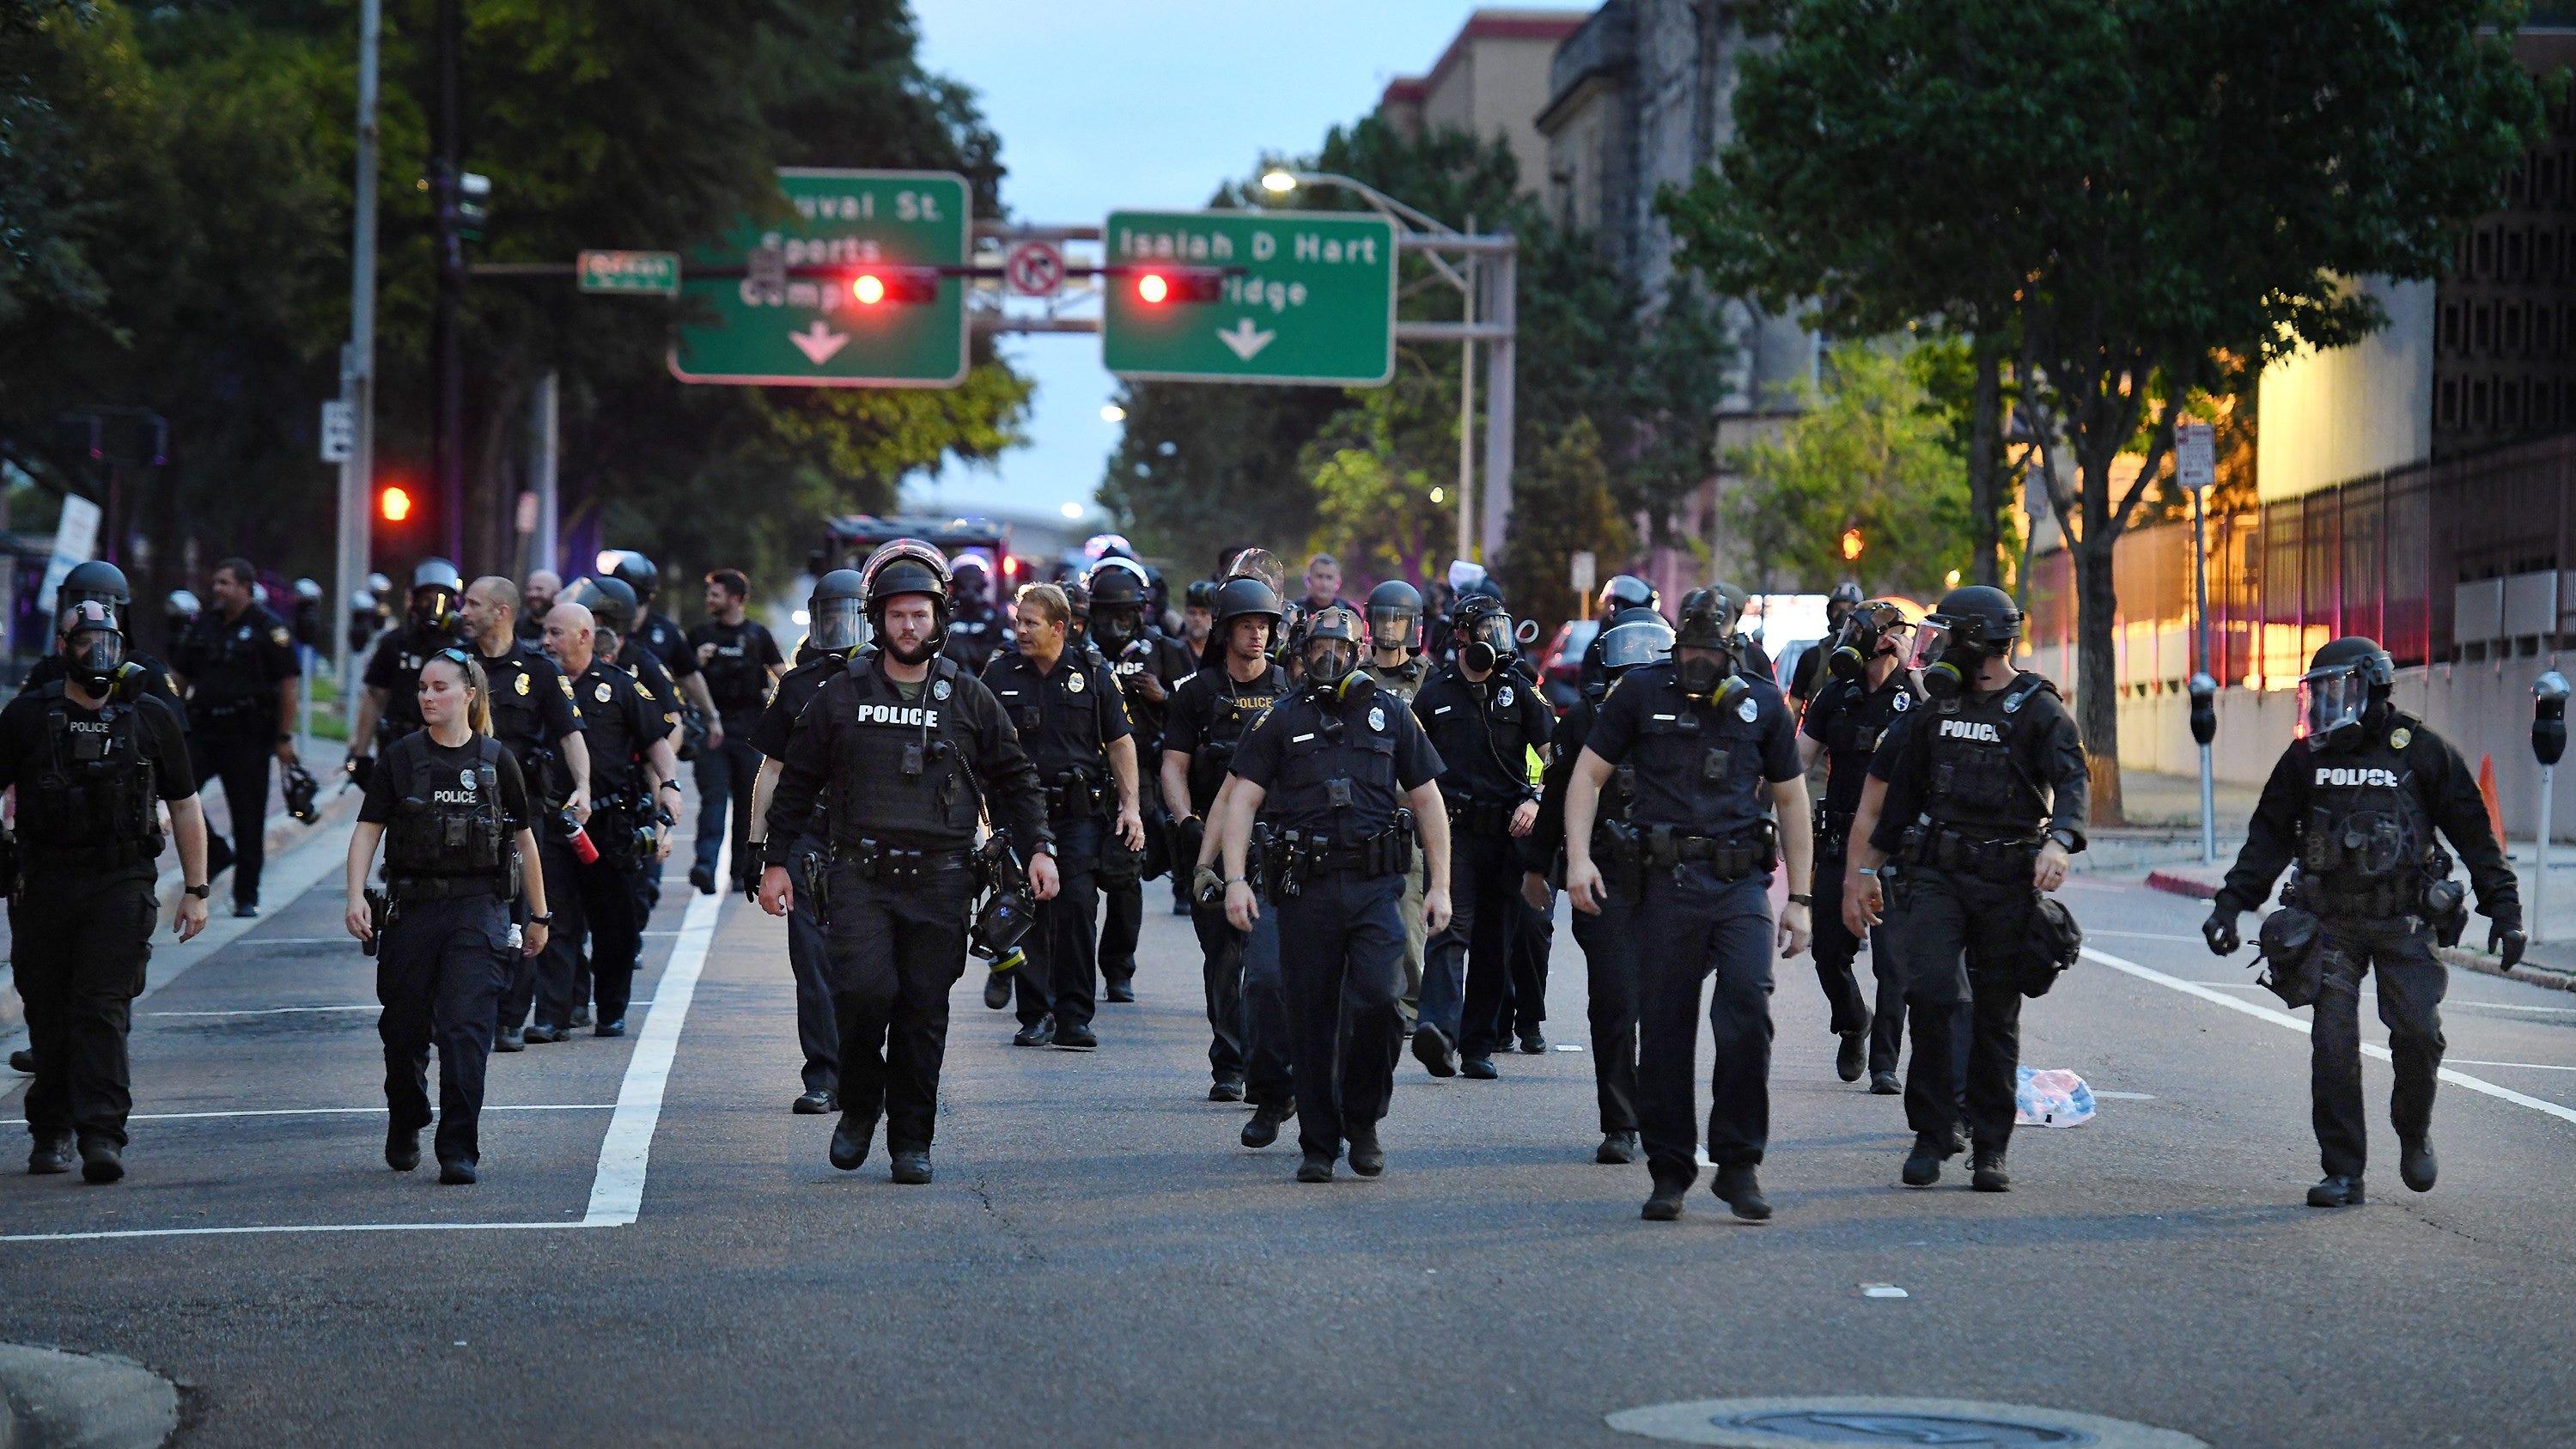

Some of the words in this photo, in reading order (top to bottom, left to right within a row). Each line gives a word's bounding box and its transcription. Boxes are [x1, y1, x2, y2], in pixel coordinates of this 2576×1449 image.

[793, 191, 874, 220] uval
[1118, 227, 1233, 258] Isaiah
[1251, 230, 1276, 261] D
[1294, 232, 1376, 264] Hart
[1221, 275, 1308, 314] idge
[70, 721, 109, 733] POLICE
[857, 704, 938, 728] POLICE
[2315, 768, 2398, 788] POLICE
[434, 790, 477, 803] POLICE
